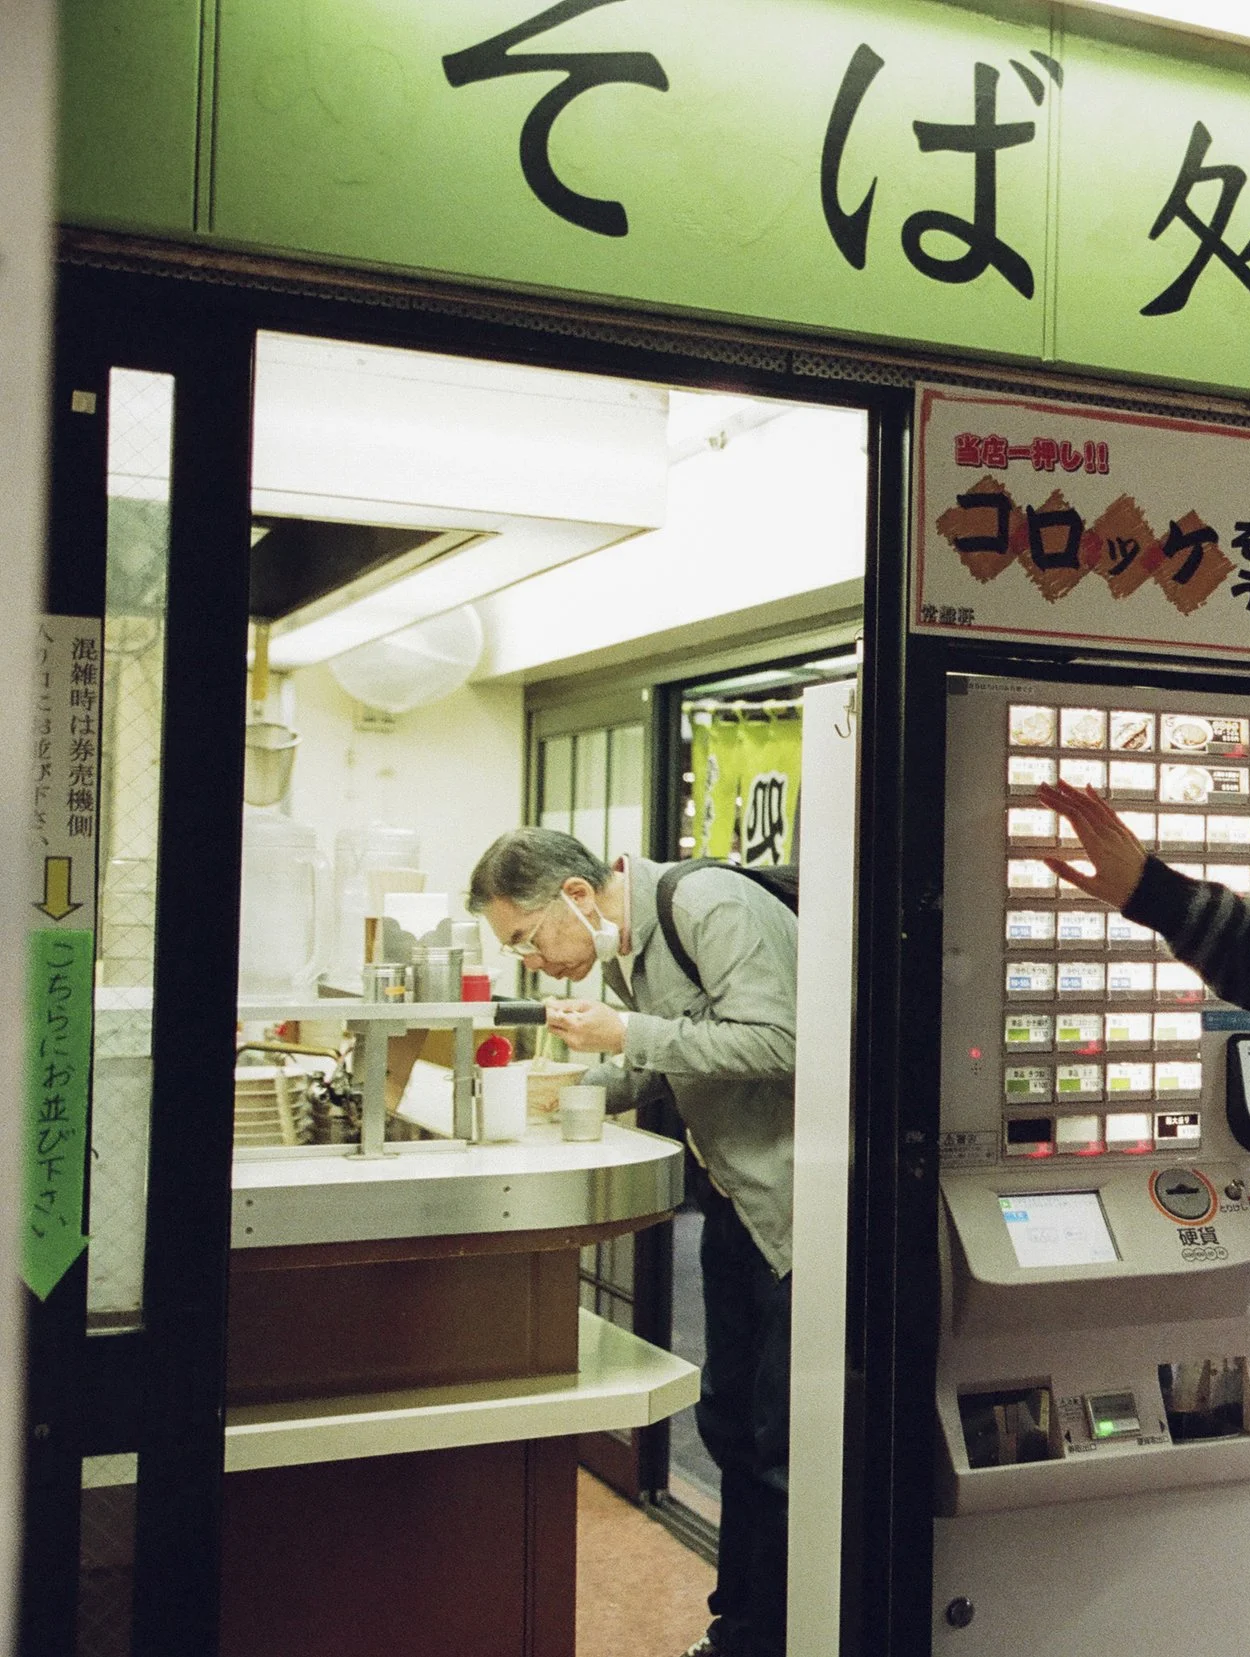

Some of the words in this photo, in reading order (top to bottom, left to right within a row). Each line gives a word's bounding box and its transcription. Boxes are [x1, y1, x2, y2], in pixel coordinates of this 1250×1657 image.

[954, 433, 1109, 473] 当店一押し!!
[952, 492, 1219, 585] コロッケ
[67, 637, 98, 838] 混雑時は券売機側
[1176, 1226, 1220, 1246] 硬貨
